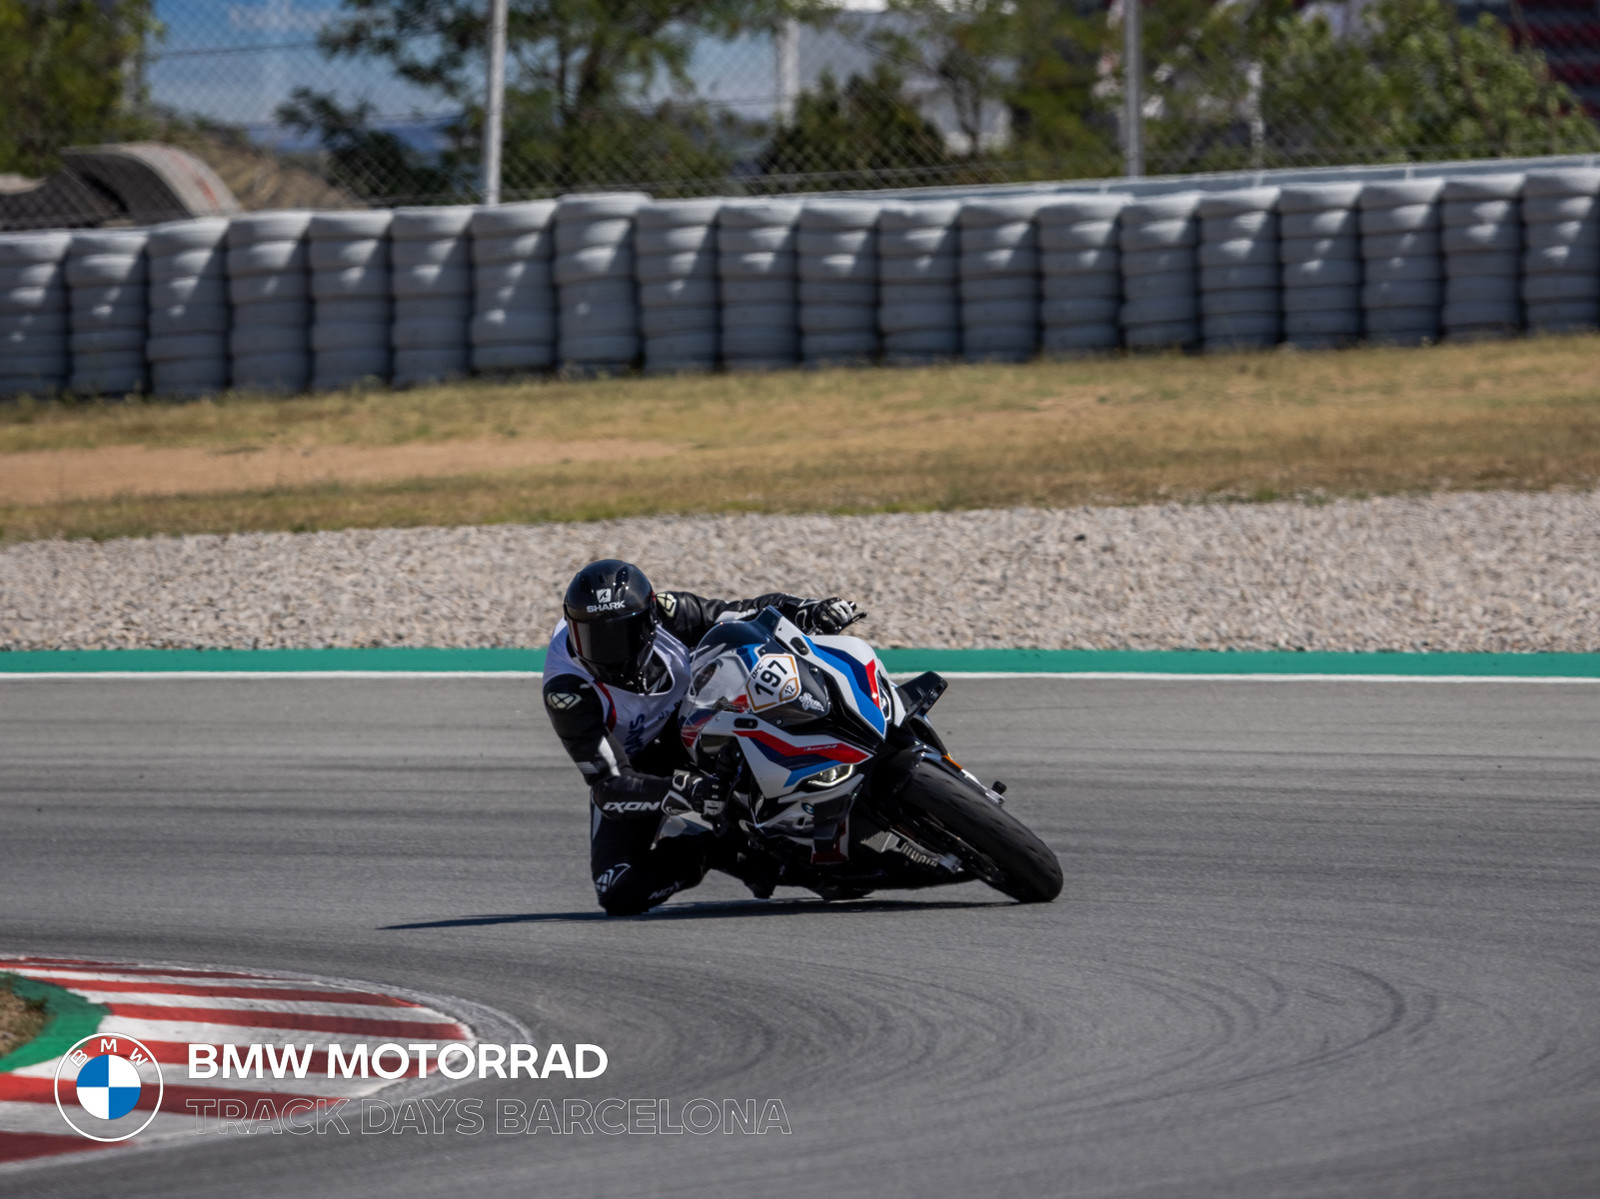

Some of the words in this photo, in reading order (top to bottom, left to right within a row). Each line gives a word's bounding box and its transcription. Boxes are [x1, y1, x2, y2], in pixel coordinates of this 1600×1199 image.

[586, 600, 626, 613] SHARK
[754, 659, 788, 697] 197
[784, 684, 796, 696] 12
